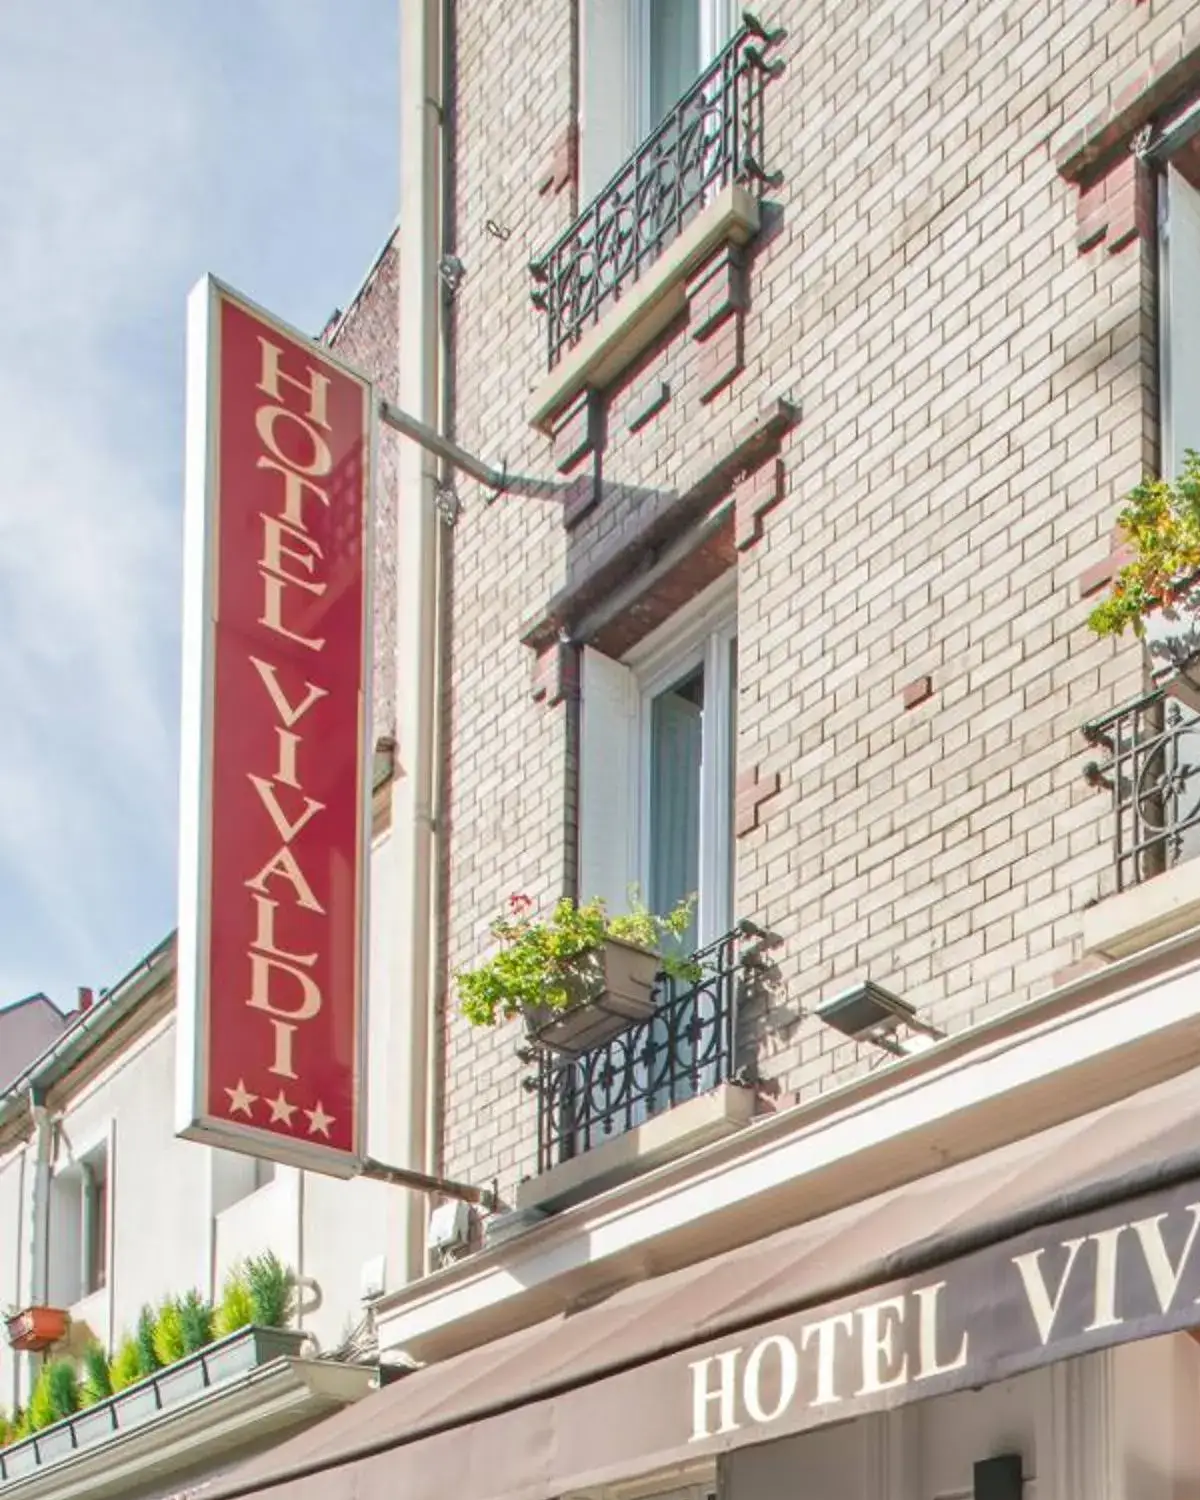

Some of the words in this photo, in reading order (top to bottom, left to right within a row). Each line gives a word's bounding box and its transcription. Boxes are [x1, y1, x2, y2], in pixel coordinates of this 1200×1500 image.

[256, 335, 332, 652] HOTEL
[244, 655, 330, 1079] VIVALDI
[687, 1280, 970, 1445] HOTEL
